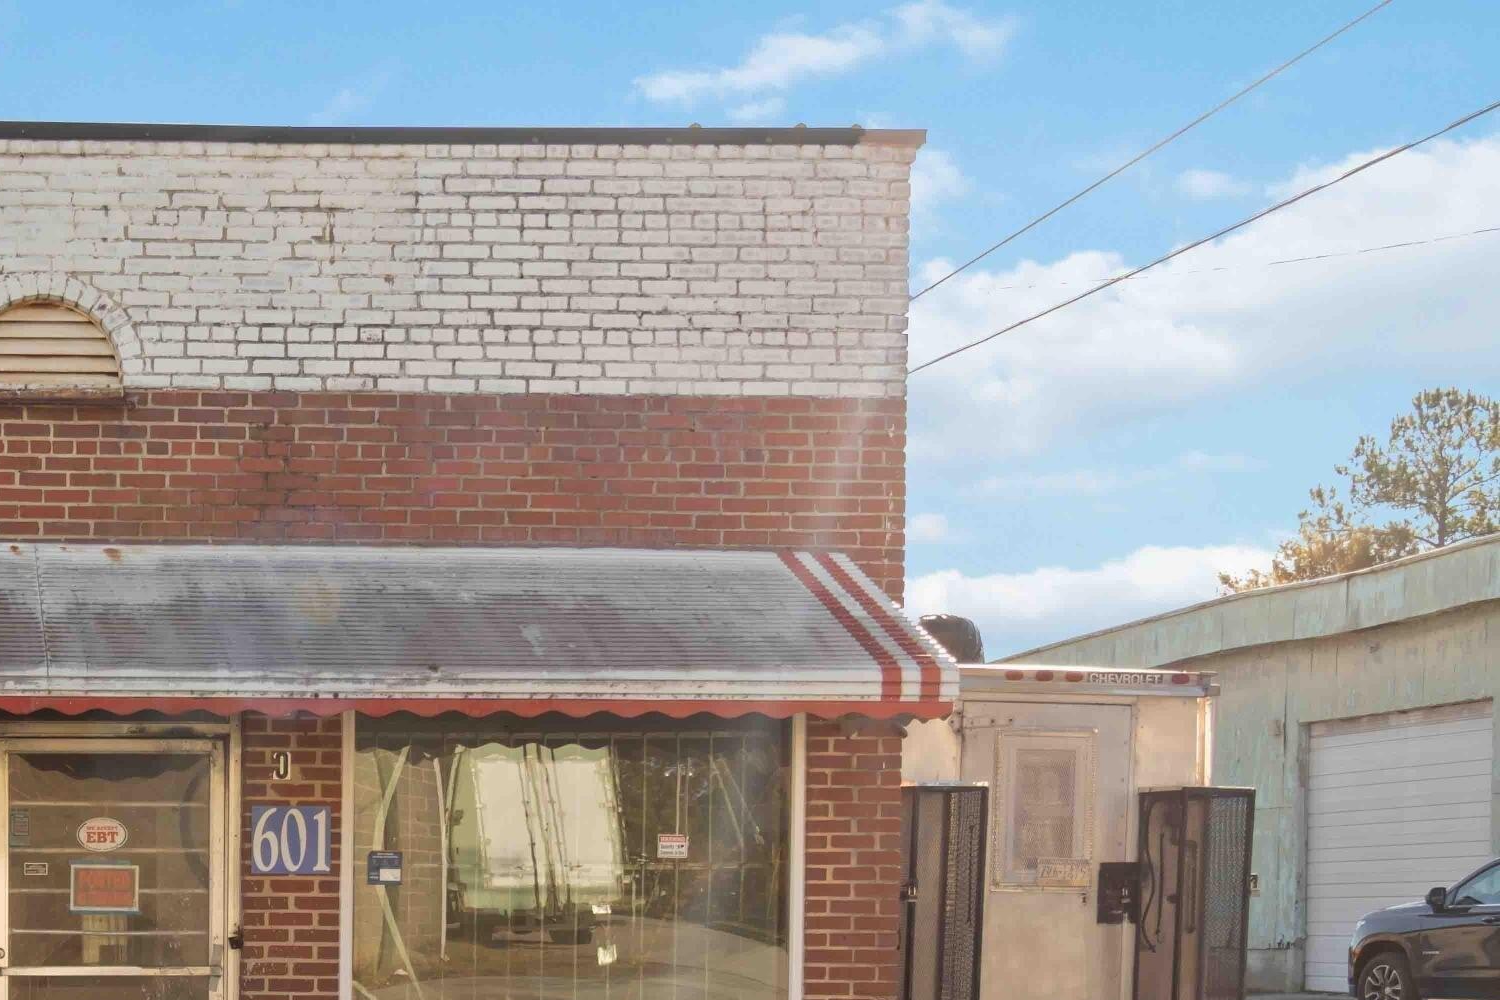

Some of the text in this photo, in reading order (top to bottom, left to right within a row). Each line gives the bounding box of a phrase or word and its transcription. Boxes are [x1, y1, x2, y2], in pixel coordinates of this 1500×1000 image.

[1089, 672, 1162, 685] CHEVROLET
[86, 831, 119, 844] EBT
[253, 807, 330, 872] 601
